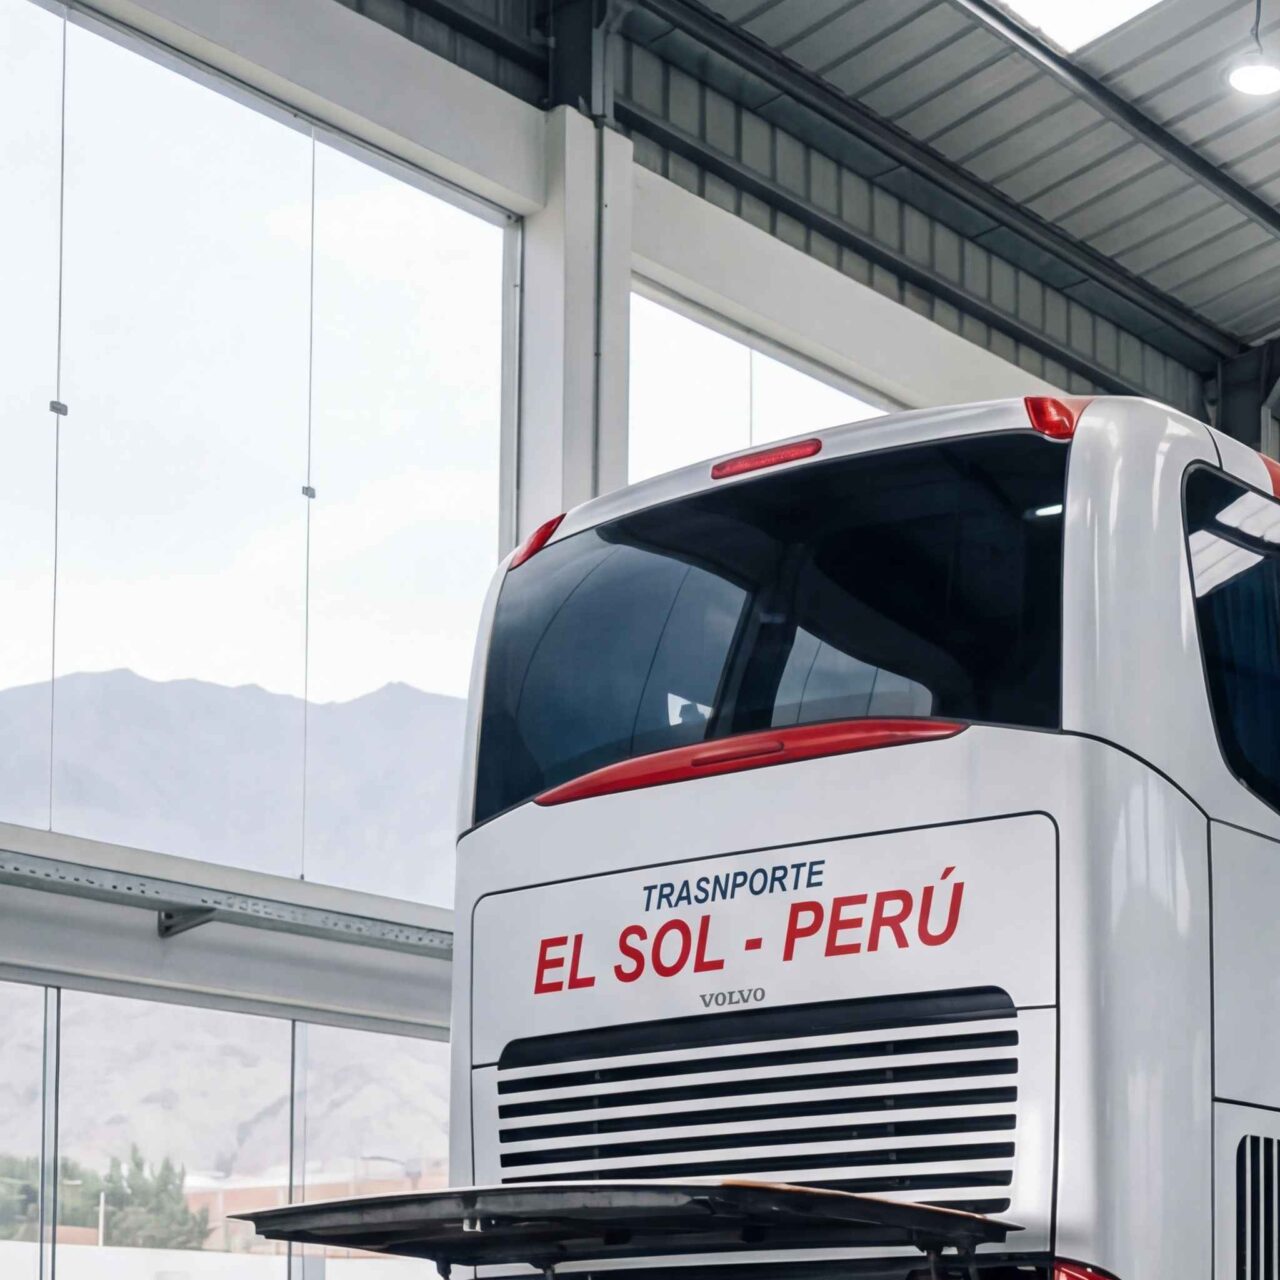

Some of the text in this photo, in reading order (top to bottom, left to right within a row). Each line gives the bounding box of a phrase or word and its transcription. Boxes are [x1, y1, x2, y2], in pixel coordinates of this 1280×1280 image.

[643, 860, 825, 912] TRASNPORTE
[533, 866, 966, 995] EL SOL - PERÚ
[699, 987, 766, 1009] VOLVO
